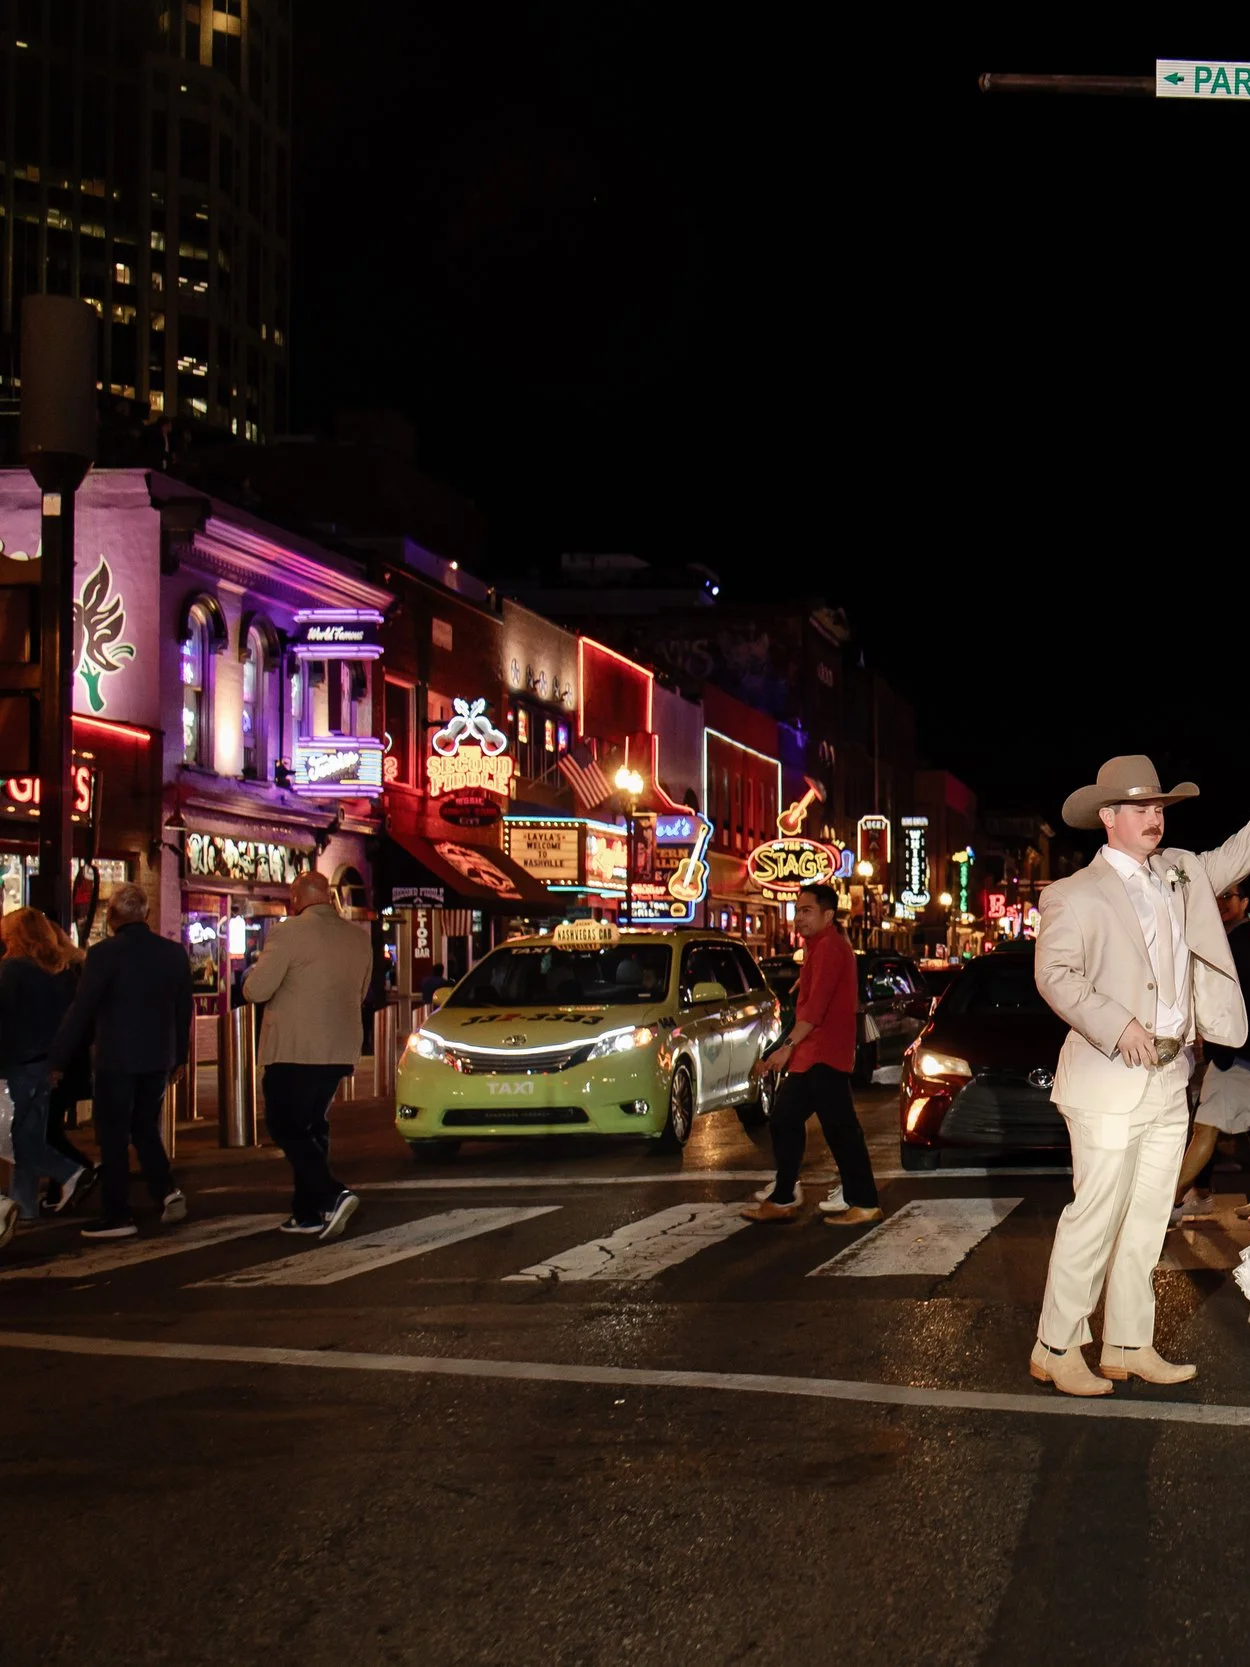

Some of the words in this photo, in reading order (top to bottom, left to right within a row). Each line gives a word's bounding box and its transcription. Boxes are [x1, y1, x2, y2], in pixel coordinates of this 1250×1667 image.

[307, 626, 334, 641] World
[334, 626, 364, 641] Famous
[426, 756, 513, 778] SECOND
[430, 772, 510, 797] FIDDLE
[527, 832, 561, 841] LAYLA'S
[526, 841, 562, 850] WELCOME
[523, 859, 565, 868] NASHVILLE
[753, 846, 833, 882] STAGE
[557, 928, 597, 941] NASHVEGAS
[599, 928, 612, 940] CAB
[414, 948, 430, 958] BAR
[511, 947, 552, 955] TAXI
[487, 1081, 534, 1096] TAXI
